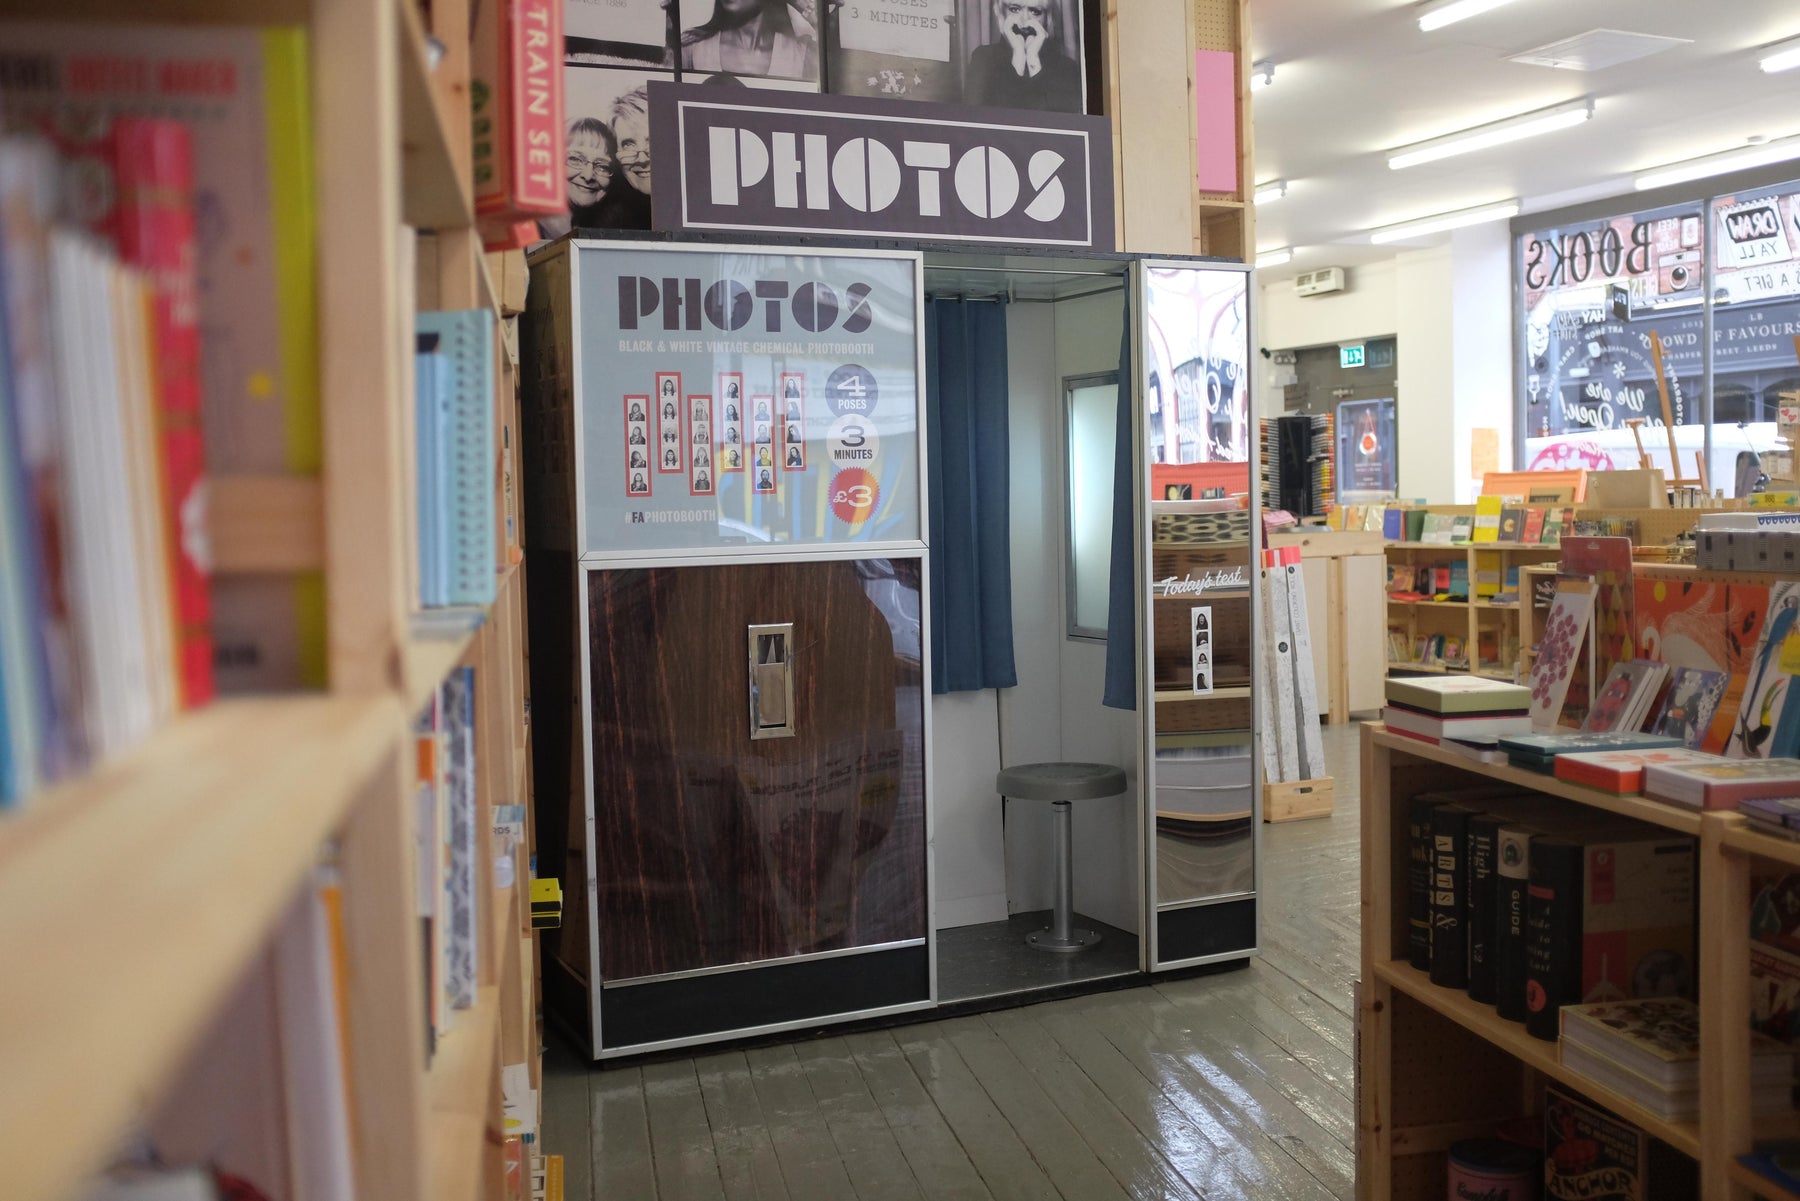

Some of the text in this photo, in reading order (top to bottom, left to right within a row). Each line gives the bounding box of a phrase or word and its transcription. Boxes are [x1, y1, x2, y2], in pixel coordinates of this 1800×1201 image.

[851, 7, 938, 29] 3 MINUTES
[526, 8, 552, 190] TRAIN SET
[708, 126, 1067, 222] PHOTOS
[618, 275, 873, 333] PHOTOS
[1662, 333, 1698, 348] OWD
[1729, 322, 1800, 341] FAVOURS
[619, 340, 875, 355] BLACK & WHITE VINTAGE CHEMICAL PHOTOBOOTH
[1715, 347, 1739, 357] REET
[837, 375, 866, 397] 4
[838, 399, 867, 410] POSES
[840, 425, 866, 447] 3
[834, 449, 873, 460] MINUTES
[832, 485, 873, 507] £3
[624, 510, 716, 524] #FAPHOTOBOOTH
[1161, 565, 1242, 597] Today's test
[1476, 834, 1491, 880] High
[1435, 836, 1457, 931] ARTS &
[1511, 890, 1521, 936] GUIDE
[1551, 1170, 1634, 1198] ANCHOR
